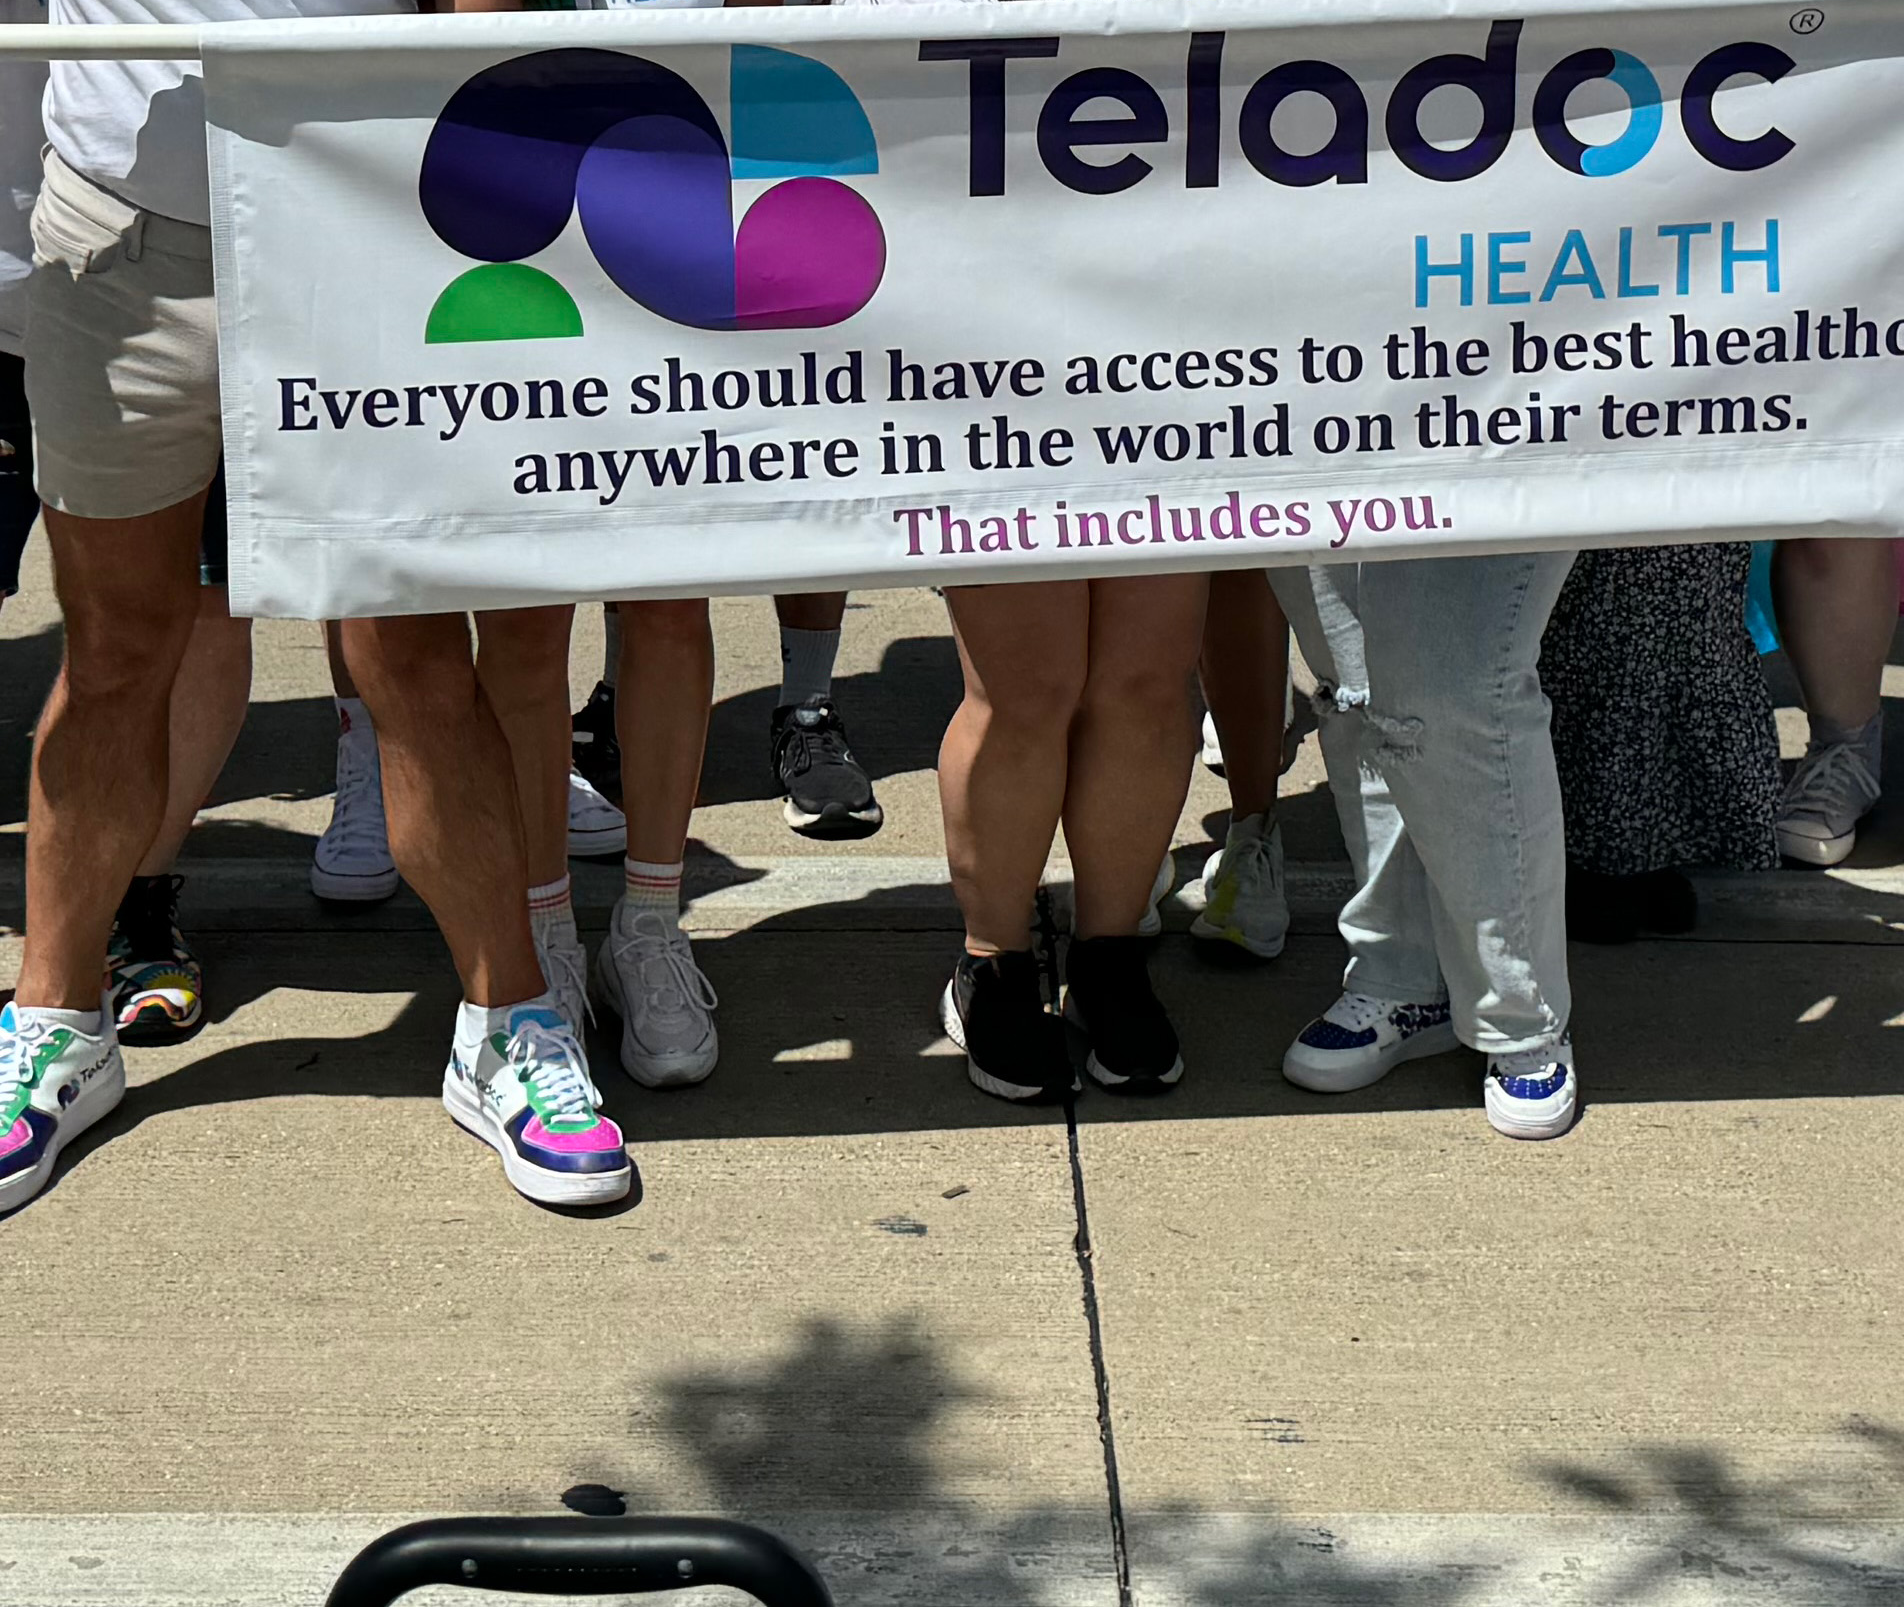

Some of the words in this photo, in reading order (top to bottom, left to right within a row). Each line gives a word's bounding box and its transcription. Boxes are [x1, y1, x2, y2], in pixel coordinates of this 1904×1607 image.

[1413, 218, 1782, 309] HEALTH
[278, 378, 608, 440] Everyone
[631, 351, 866, 414] should
[886, 349, 1044, 401] have
[1066, 348, 1278, 394] access
[1298, 338, 1362, 383] to
[1383, 326, 1489, 380] the
[1510, 321, 1653, 373] best
[514, 430, 858, 505] anywhere
[880, 422, 945, 474] in
[964, 416, 1073, 470] the
[1093, 403, 1293, 464] world
[1314, 414, 1395, 453] on
[1415, 393, 1580, 448] their
[1599, 395, 1806, 439] terms.
[894, 506, 1038, 555] That
[1055, 491, 1310, 547] includes
[1328, 497, 1451, 548] you.
